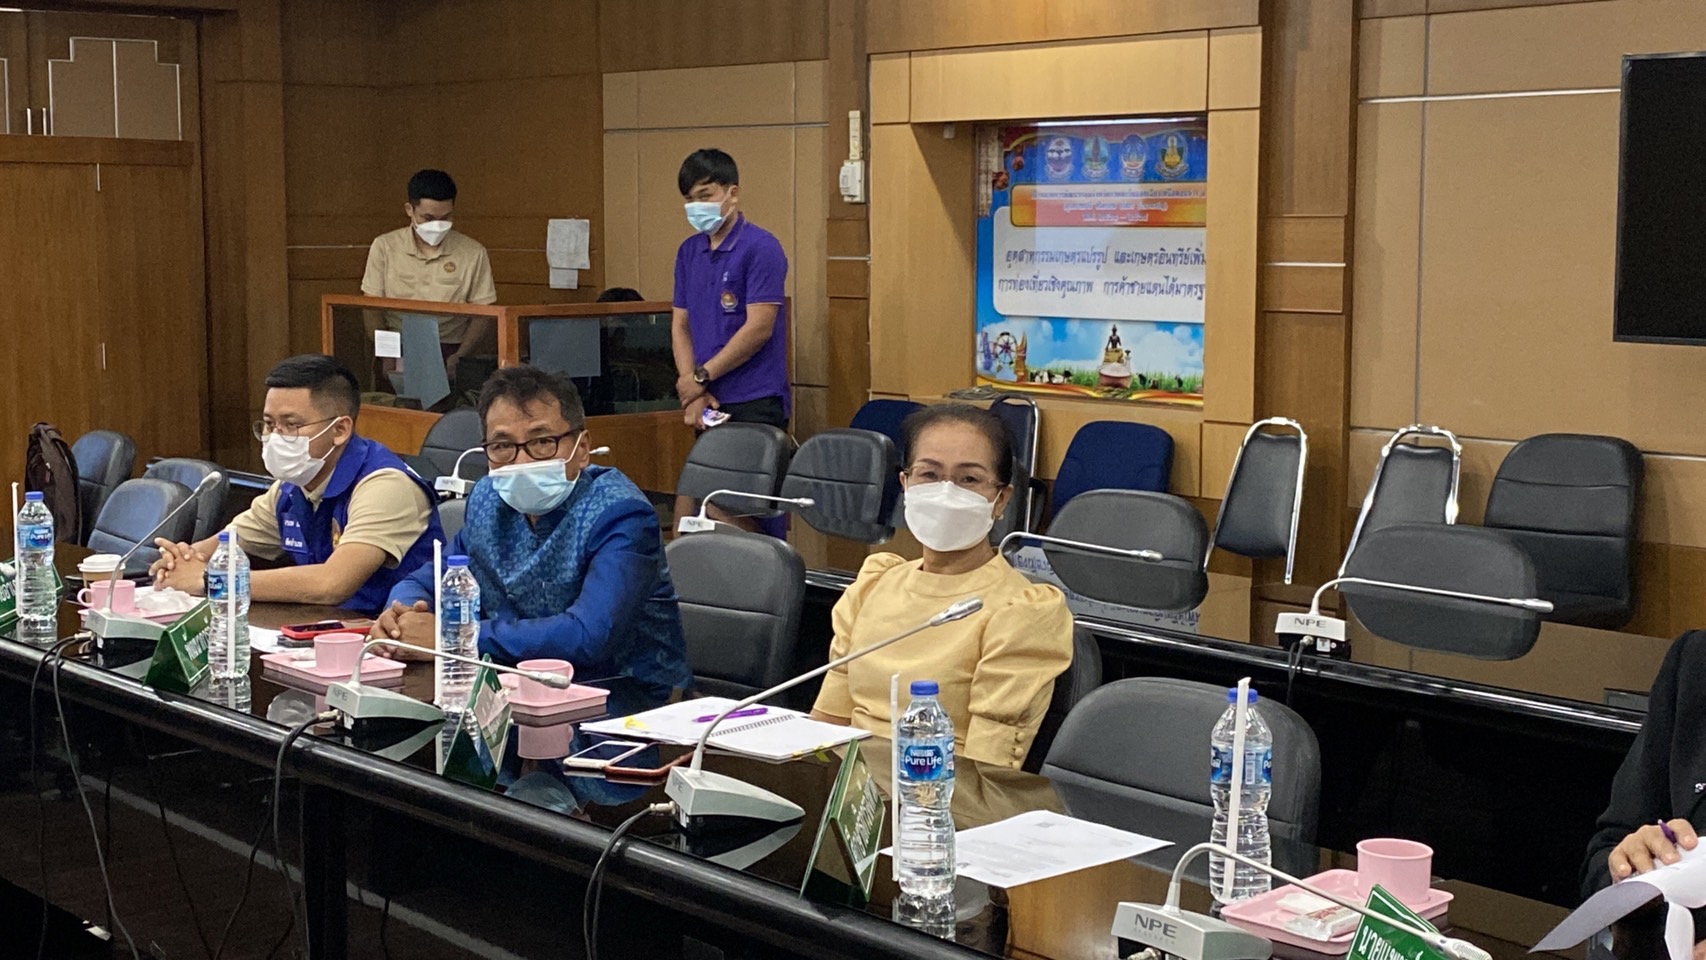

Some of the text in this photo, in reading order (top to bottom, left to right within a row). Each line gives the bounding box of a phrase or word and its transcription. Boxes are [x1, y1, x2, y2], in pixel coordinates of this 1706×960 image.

[1294, 617, 1327, 629] NPE
[905, 755, 943, 769] Pure Life
[1134, 913, 1179, 940] NPE
